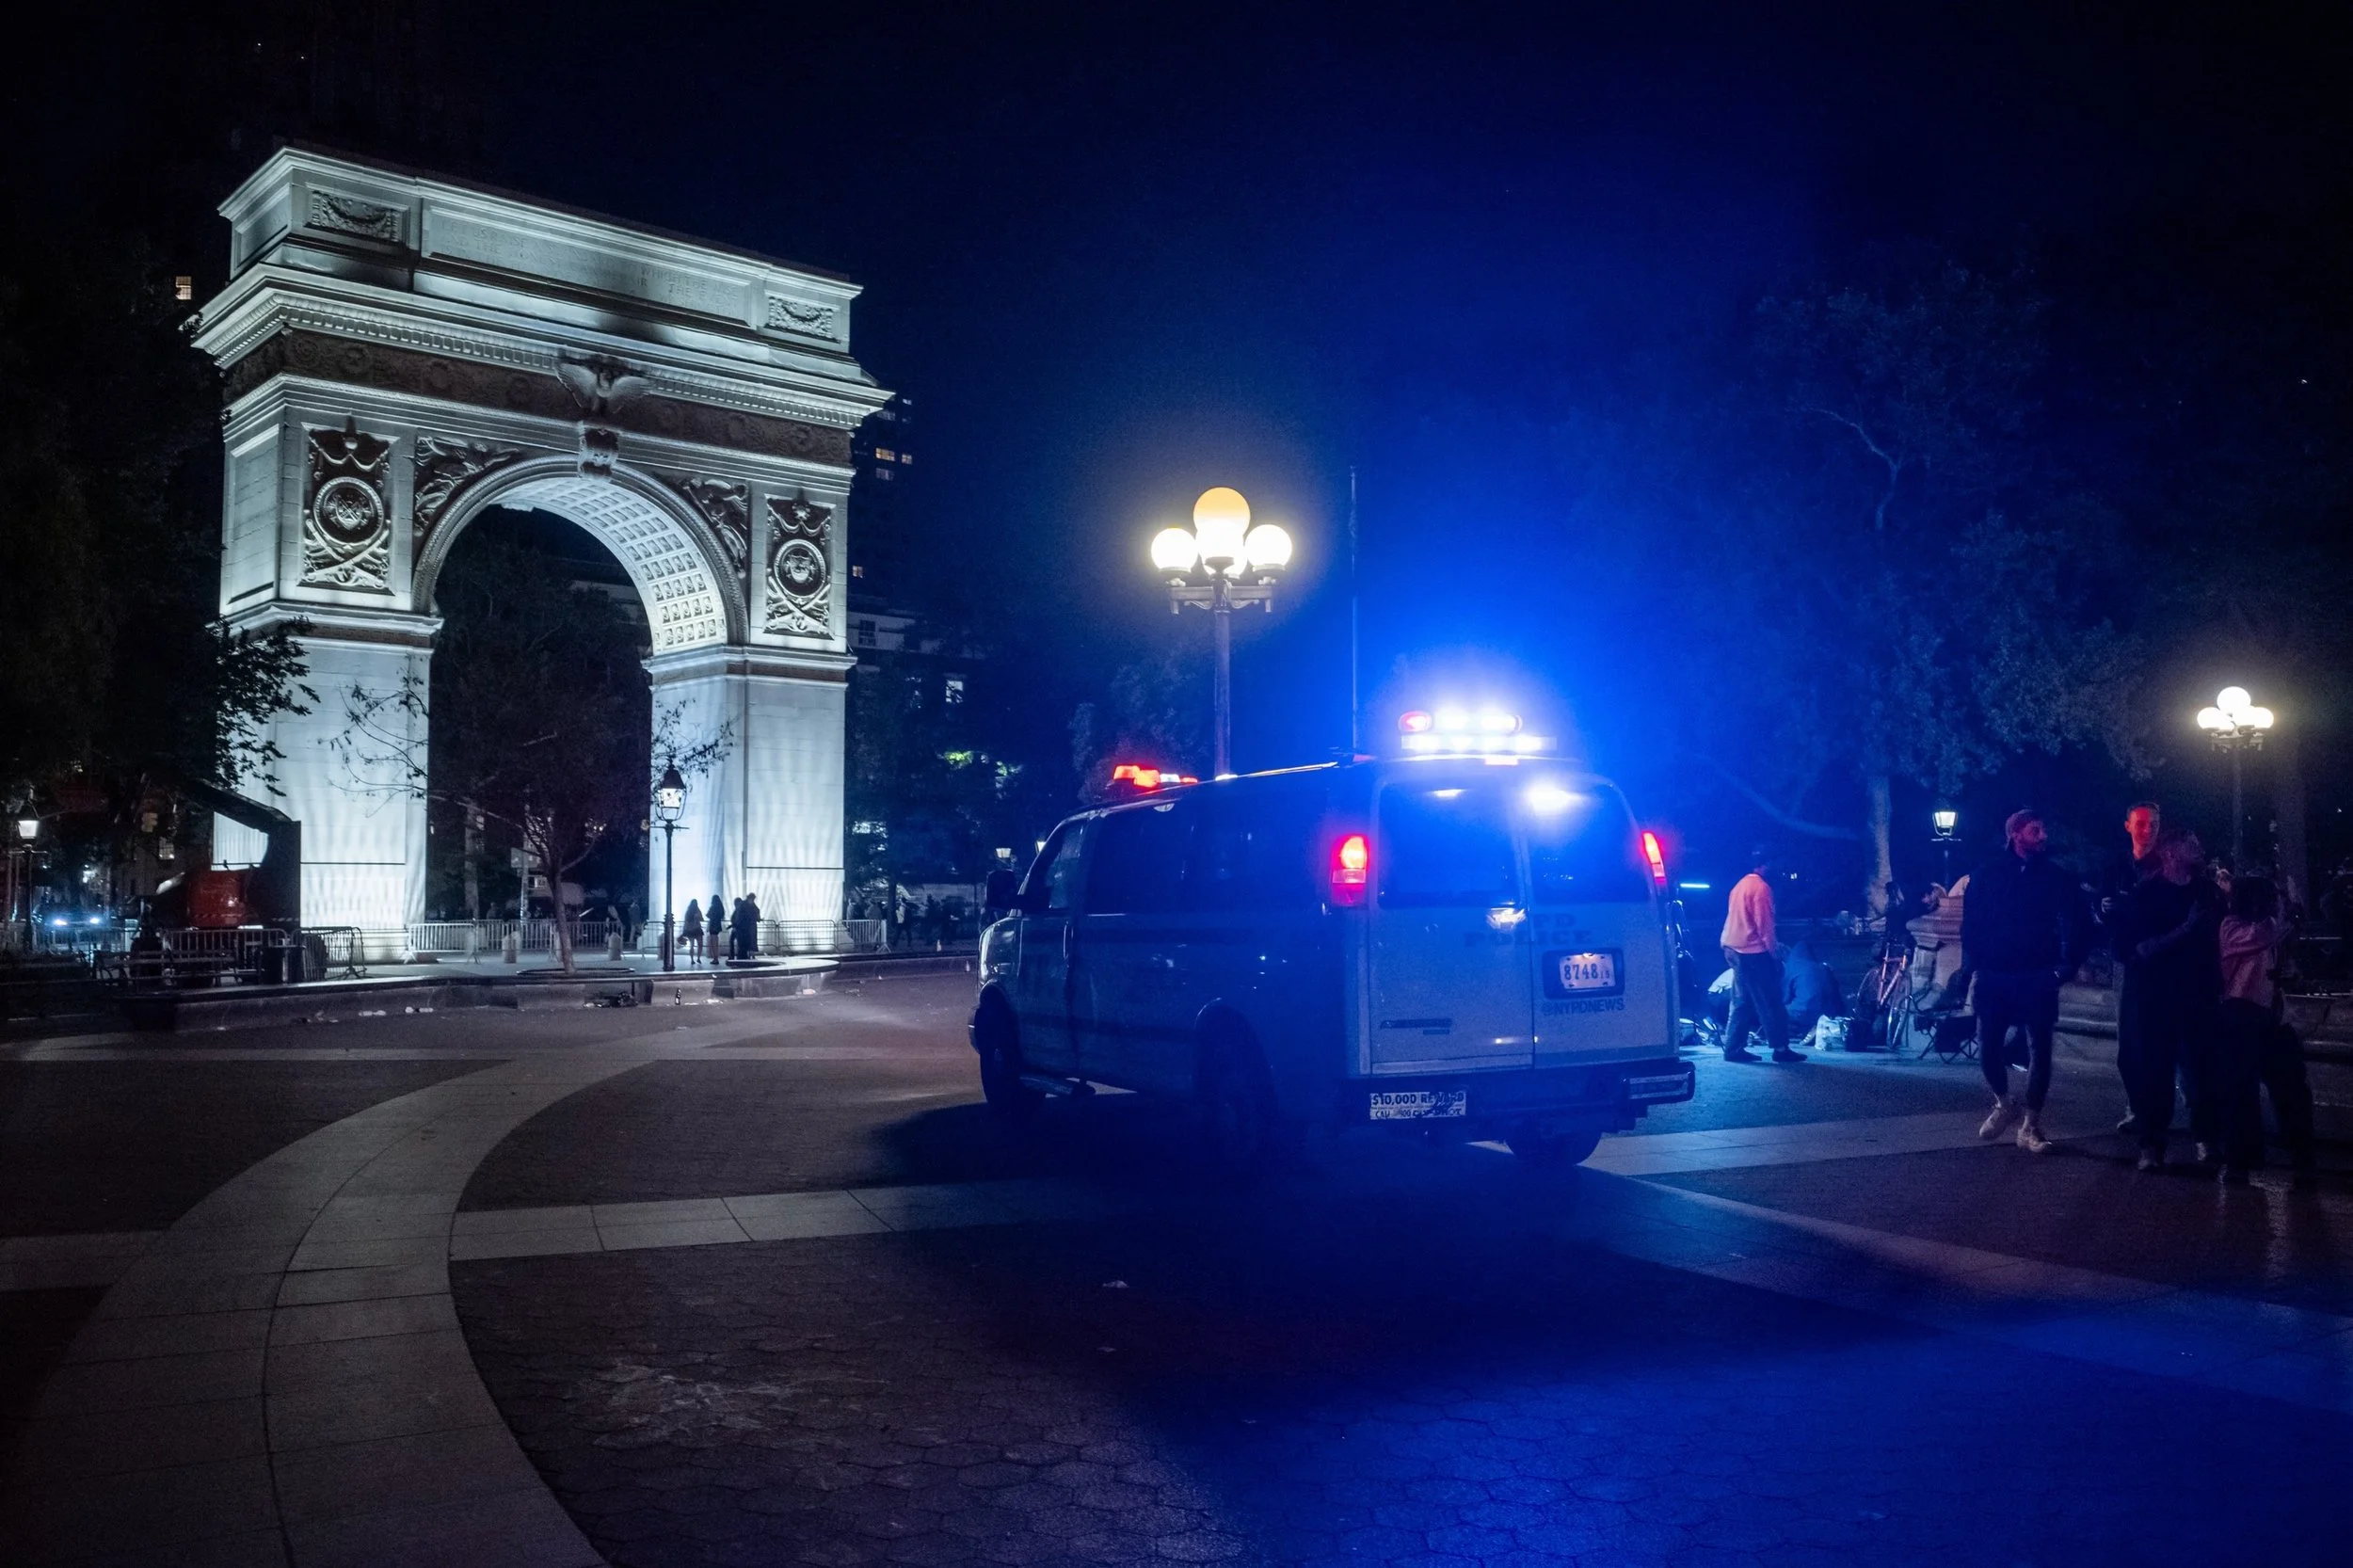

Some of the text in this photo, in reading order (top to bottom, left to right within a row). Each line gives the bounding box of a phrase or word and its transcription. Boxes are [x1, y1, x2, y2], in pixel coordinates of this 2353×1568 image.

[1464, 929, 1593, 948] POLICE
[1563, 963, 1598, 981] 8748
[1372, 1094, 1417, 1106] $10,000
